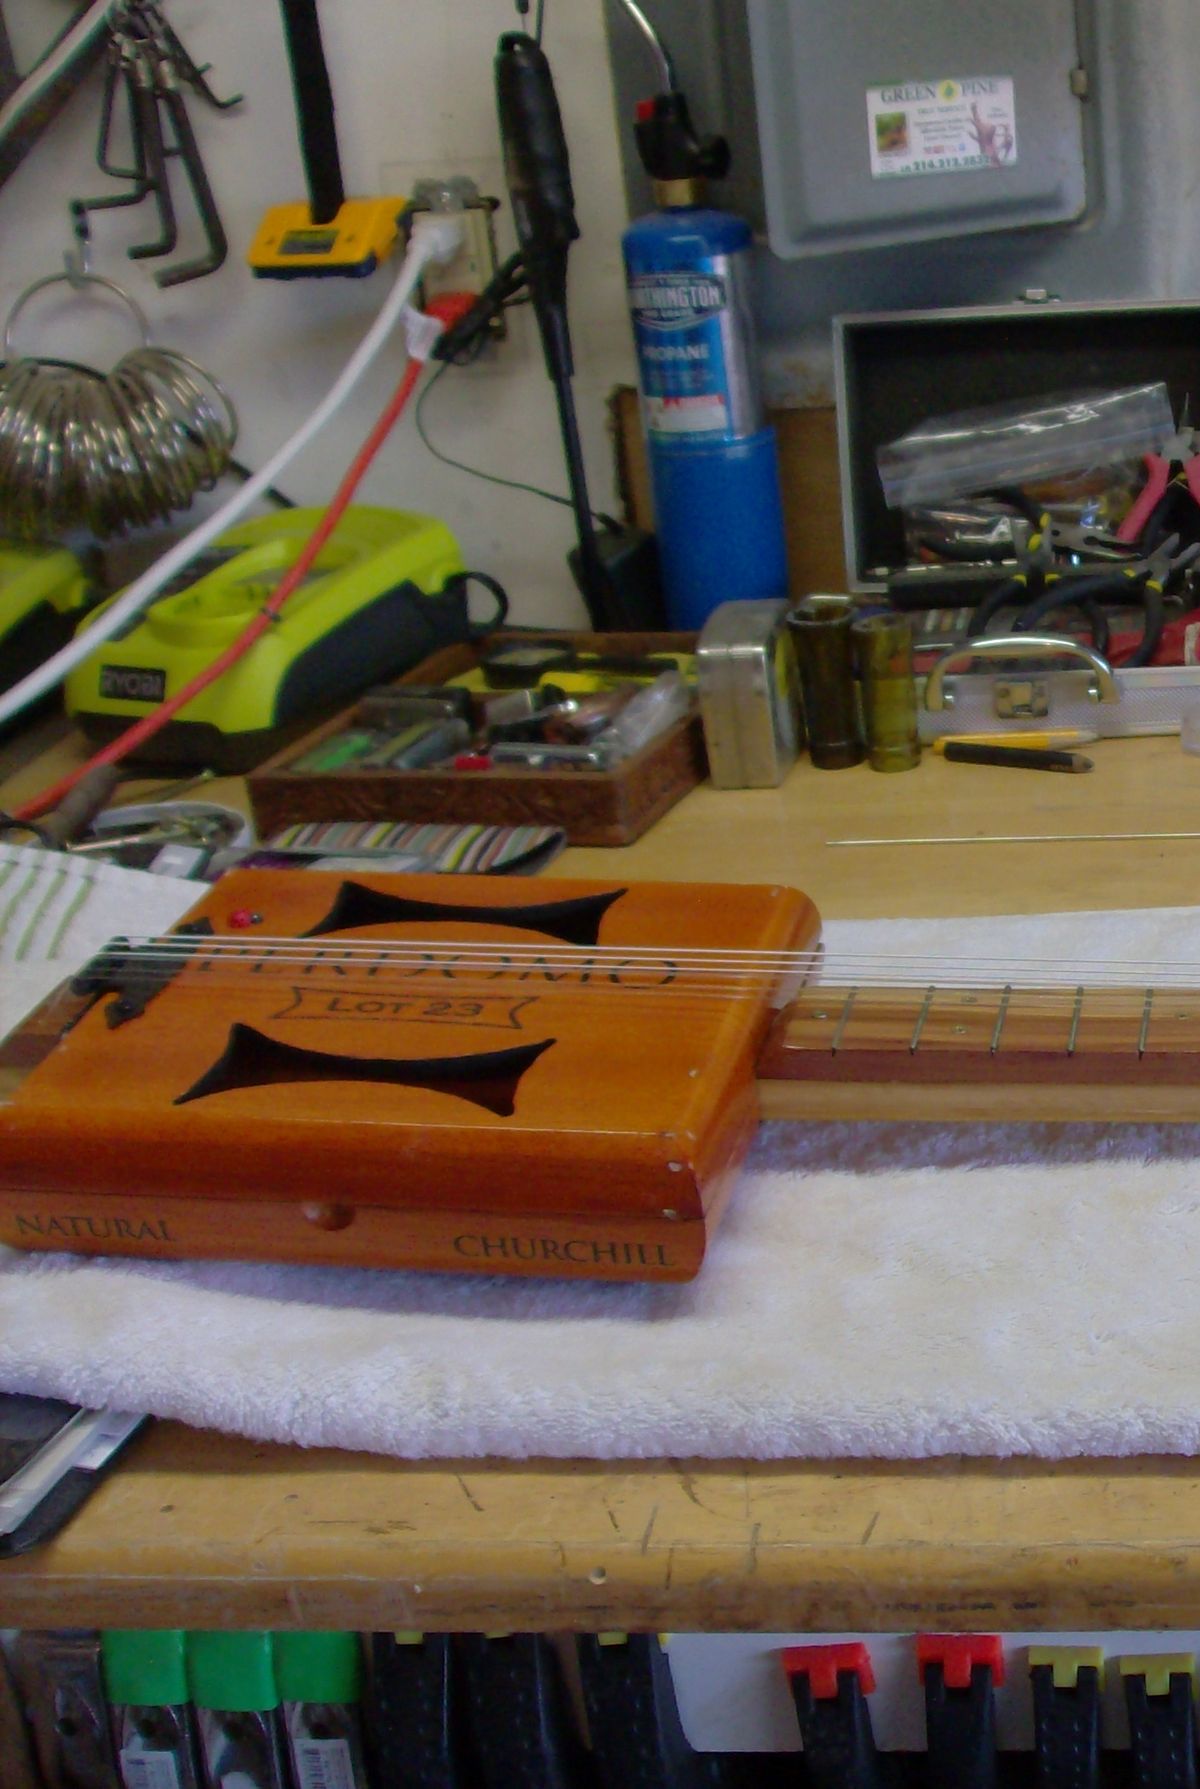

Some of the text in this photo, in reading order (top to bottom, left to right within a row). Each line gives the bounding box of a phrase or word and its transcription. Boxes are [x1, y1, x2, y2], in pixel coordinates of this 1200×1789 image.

[881, 80, 998, 103] GREEN PINE
[102, 669, 162, 697] RYOBI
[326, 997, 484, 1017] LOT 23
[16, 1215, 177, 1242] NATURAL
[453, 1235, 675, 1266] CHURCHILL
